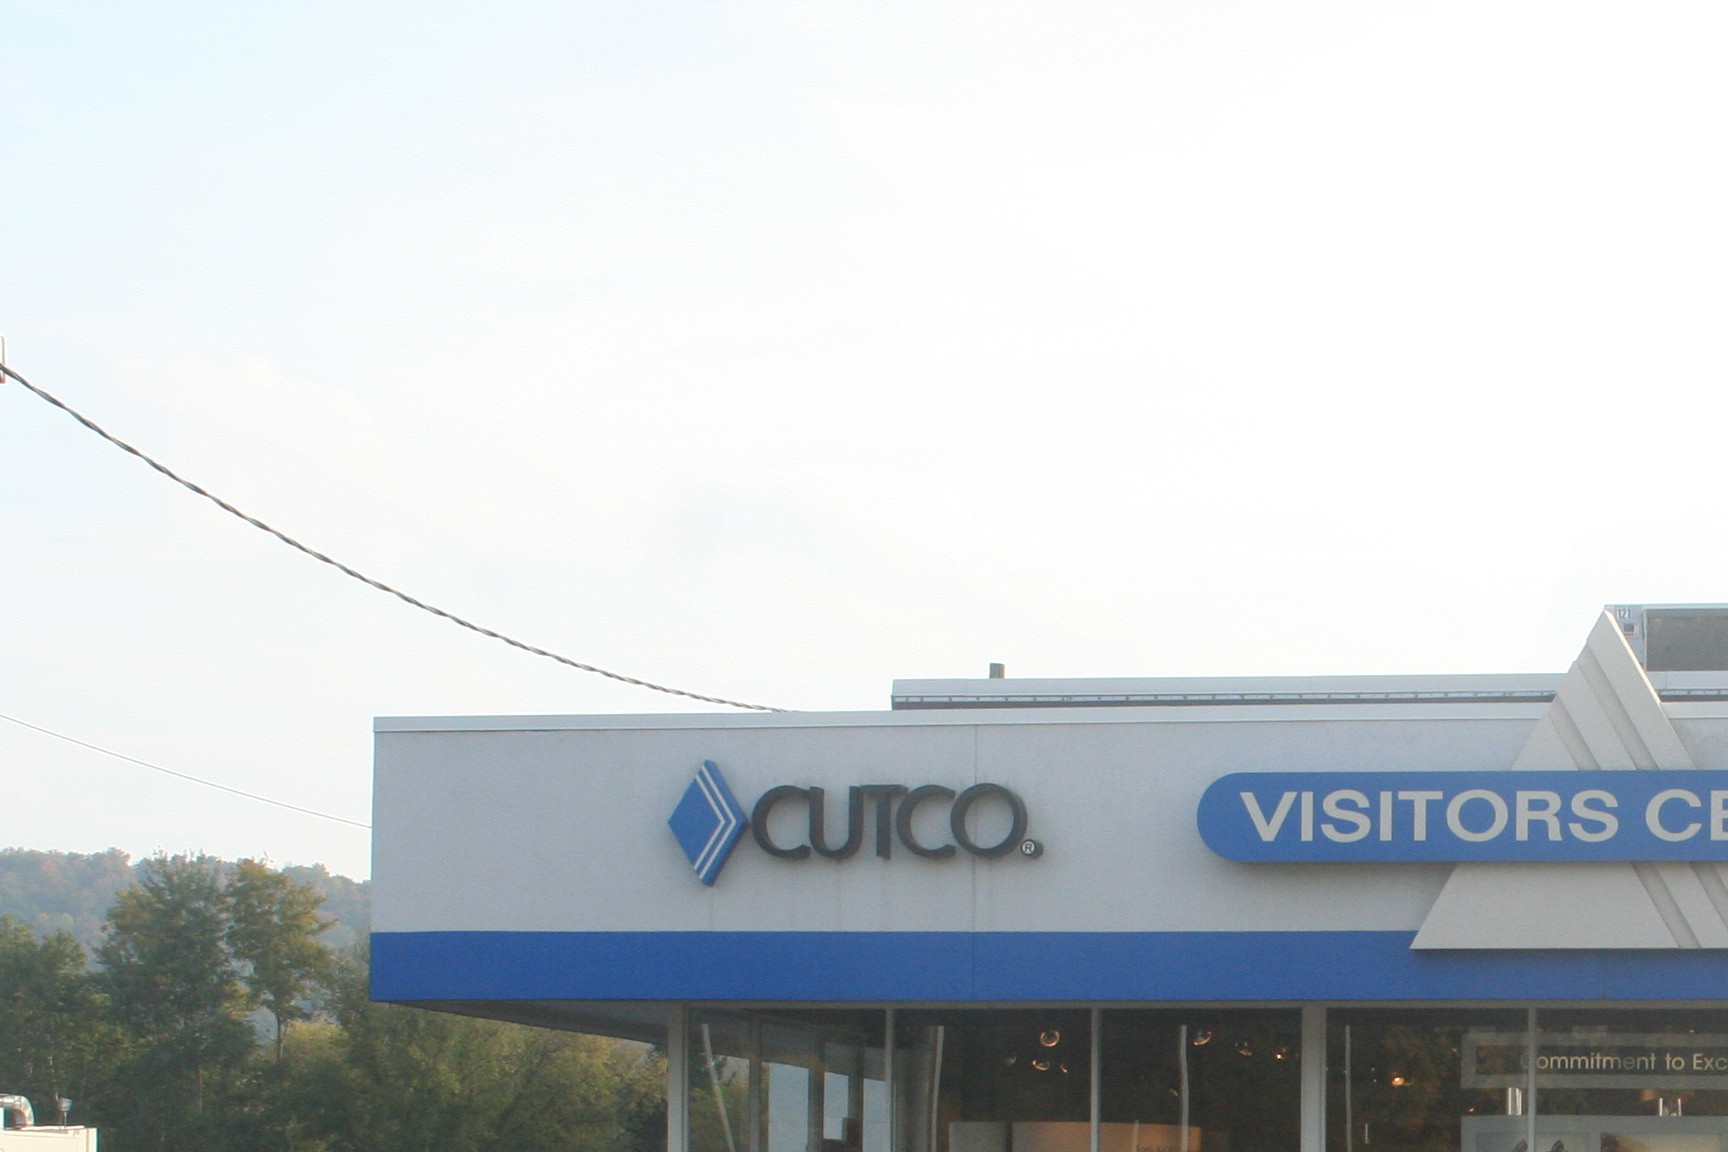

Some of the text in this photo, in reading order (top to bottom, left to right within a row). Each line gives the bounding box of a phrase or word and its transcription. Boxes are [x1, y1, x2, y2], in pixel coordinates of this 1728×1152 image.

[752, 783, 1028, 859] CUTCO
[1240, 789, 1619, 842] VISITORS
[1665, 1053, 1685, 1070] to
